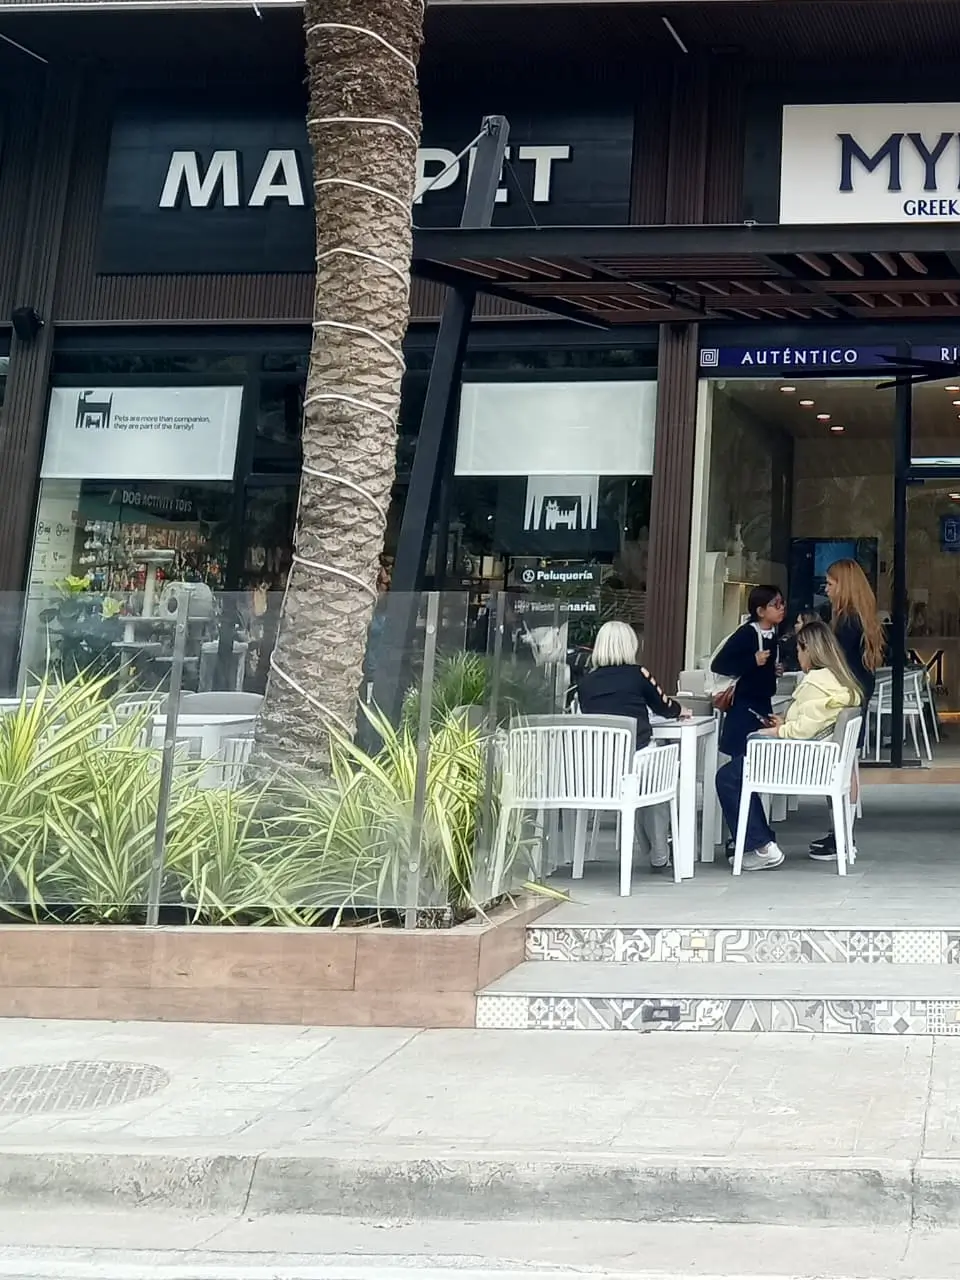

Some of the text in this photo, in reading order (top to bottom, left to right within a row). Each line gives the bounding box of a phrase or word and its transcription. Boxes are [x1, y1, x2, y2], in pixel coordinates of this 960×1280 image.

[903, 199, 960, 215] GREEK
[741, 347, 858, 365] AUTÉNTICO
[122, 490, 142, 505] DOG
[175, 498, 193, 513] TOYS
